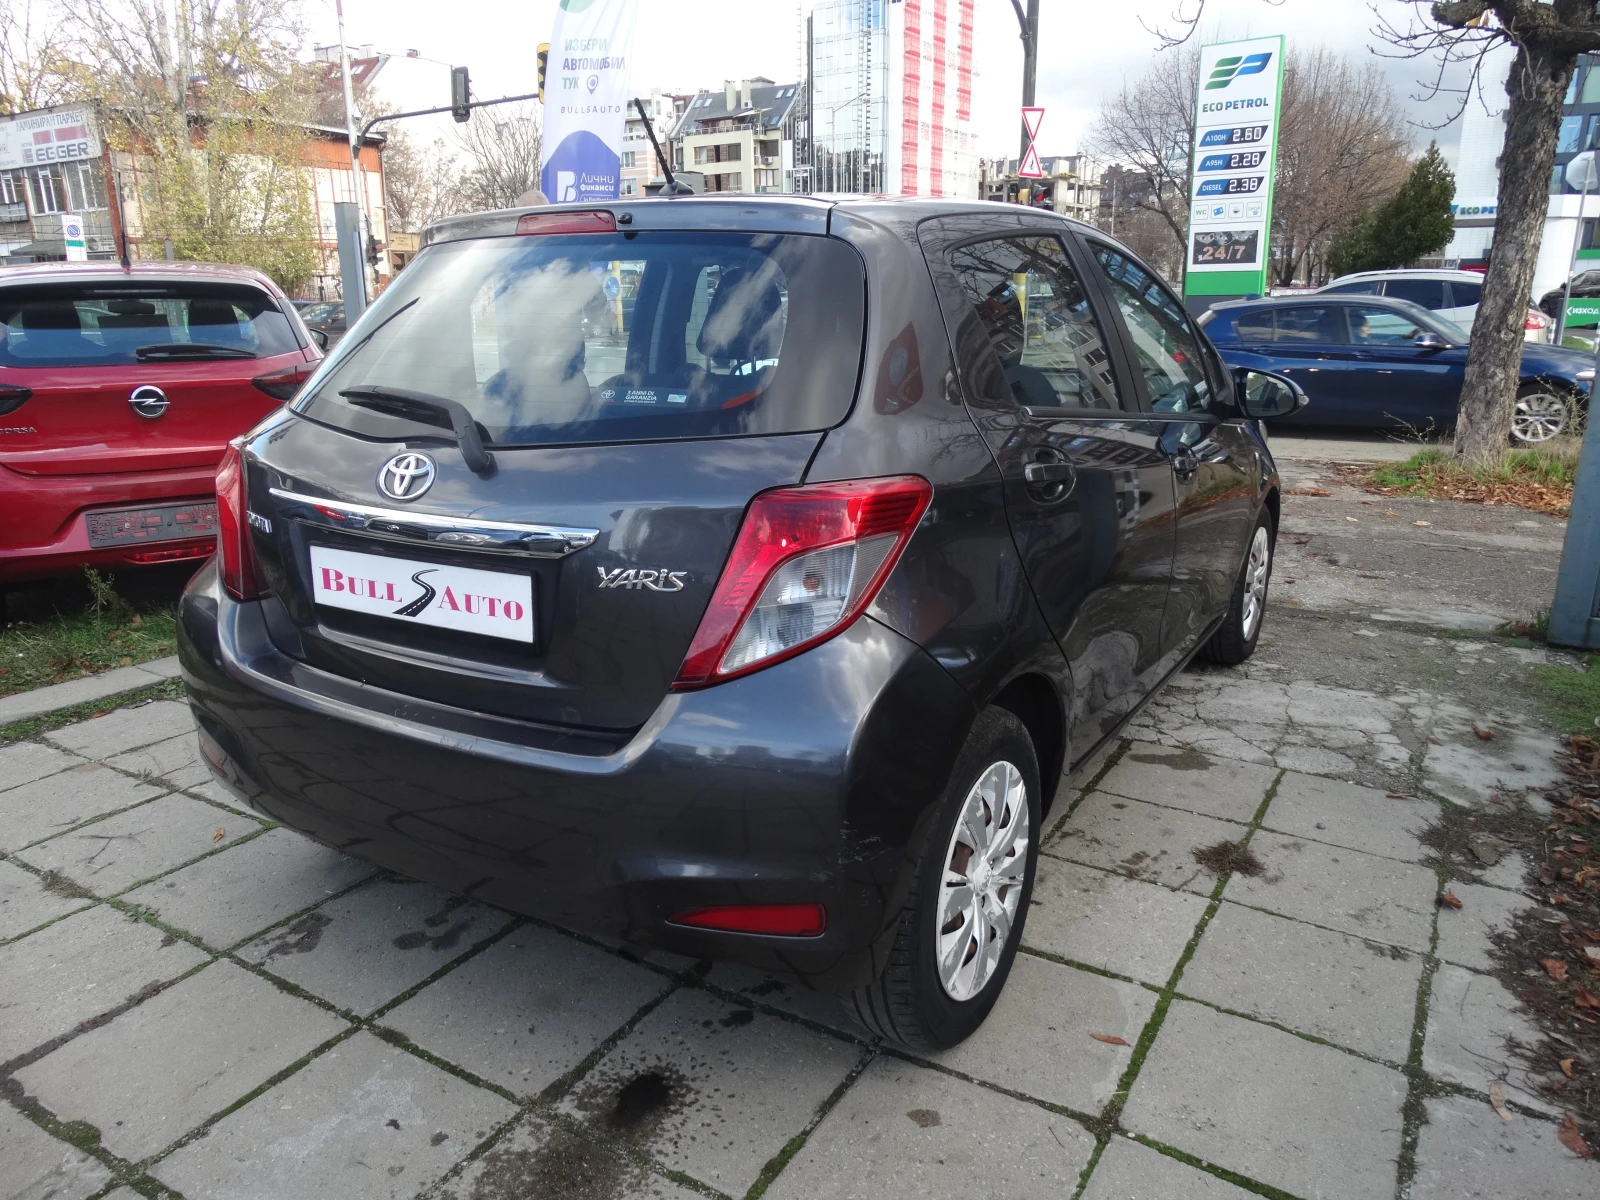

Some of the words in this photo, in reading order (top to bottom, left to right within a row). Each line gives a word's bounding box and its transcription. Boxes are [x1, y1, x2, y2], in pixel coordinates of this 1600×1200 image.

[564, 38, 608, 52] ИЗБЕРИ
[562, 56, 626, 71] АВТОМОБИЛ
[561, 77, 580, 90] ТУК
[560, 105, 621, 114] BULLSAUTO
[1232, 127, 1262, 142] 2.60
[35, 142, 90, 162] EGGER
[1231, 152, 1260, 167] 2.28
[580, 172, 614, 183] Лични
[1229, 177, 1258, 191] 2.38
[1202, 245, 1246, 261] 24/7
[1572, 306, 1600, 316] ИЗХОД
